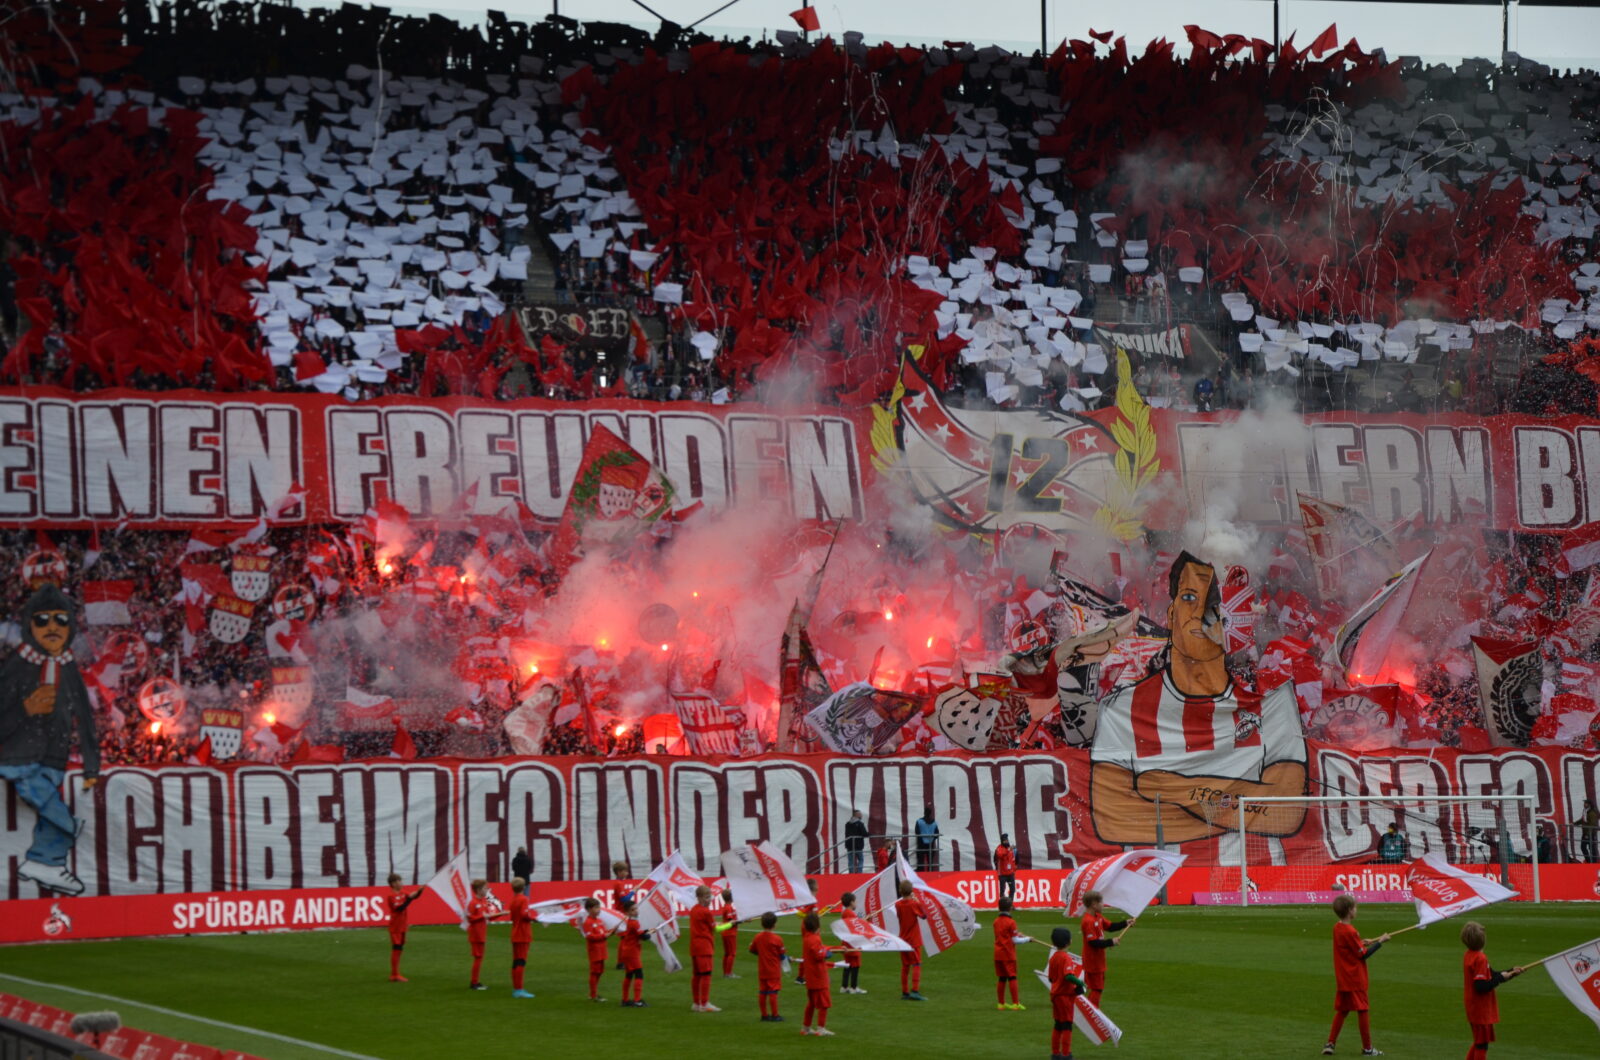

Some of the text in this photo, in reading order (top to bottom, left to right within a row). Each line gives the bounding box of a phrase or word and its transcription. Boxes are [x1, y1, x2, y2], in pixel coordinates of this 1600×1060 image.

[327, 405, 865, 523] FREUNDEN
[986, 434, 1069, 512] 12
[1177, 423, 1495, 528] EIERN
[236, 764, 453, 887] BEIM
[461, 761, 567, 882] FC
[573, 760, 664, 881] IN
[671, 760, 822, 876] DER
[828, 757, 1071, 870] KURVE
[172, 897, 390, 929] SPÜRBAR ANDERS.
